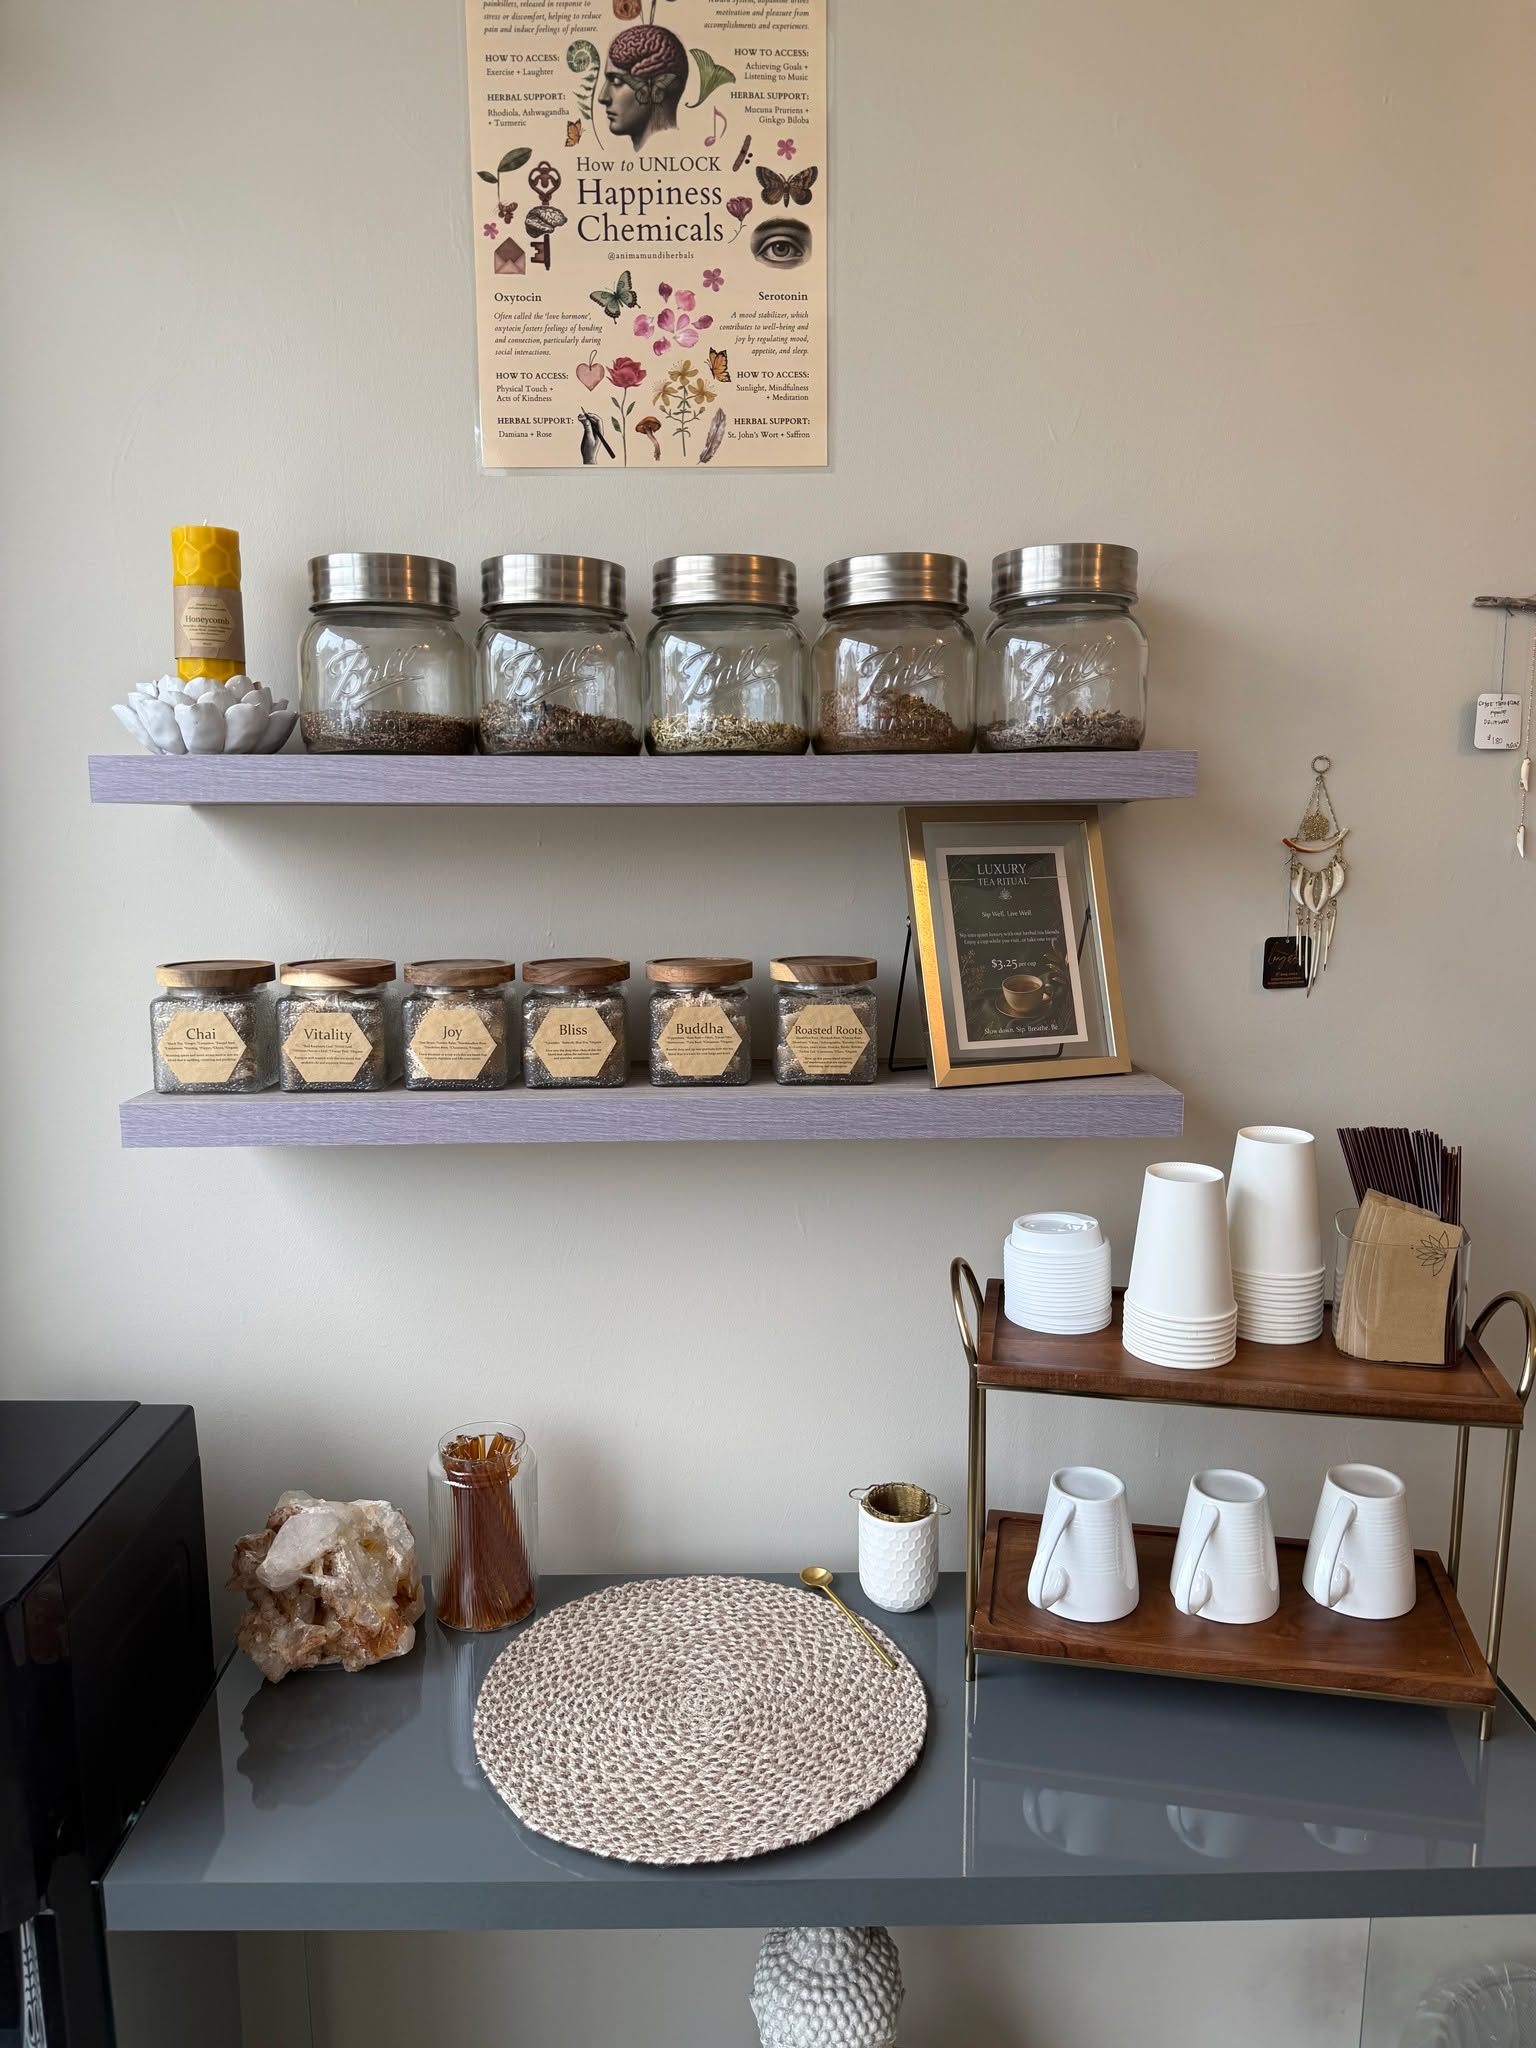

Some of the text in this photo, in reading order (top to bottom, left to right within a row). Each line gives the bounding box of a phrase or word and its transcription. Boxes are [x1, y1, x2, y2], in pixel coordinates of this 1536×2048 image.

[511, 12, 547, 22] discomfort,
[548, 12, 571, 22] helping
[582, 11, 602, 19] reduce
[716, 8, 809, 19] motivation and pleasure from
[484, 24, 598, 35] pain and induce feelings of pleasure.
[704, 20, 809, 32] accomplishments and experiences.
[734, 48, 757, 56] HOW
[775, 49, 809, 57] ACCESS:
[485, 54, 560, 62] HOW TO ACCESS:
[486, 68, 514, 76] Exercise
[523, 67, 554, 77] Laughter
[745, 62, 781, 72] Achieving
[783, 63, 802, 71] Goals
[744, 72, 777, 82] Listening
[779, 73, 786, 81] to
[487, 92, 566, 102] HERBAL SUPPORT:
[730, 91, 809, 100] HERBAL SUPPORT:
[488, 107, 570, 118] Rhodiola, Ashwagandha
[774, 106, 803, 114] Pruriens
[494, 119, 527, 127] Turmeric
[759, 116, 809, 126] Ginkgo Biloba
[576, 156, 721, 172] How to UNLOCK
[577, 178, 722, 215] Happiness
[577, 212, 723, 242] Chemicals
[607, 251, 694, 260] @animamundiherbals
[494, 292, 542, 304] Oxytocin
[758, 291, 808, 301] Serotonin
[494, 312, 512, 321] Often
[514, 312, 532, 320] called
[534, 312, 543, 320] the
[758, 311, 789, 319] stabilizer,
[494, 324, 603, 333] oxytocin fosters feelings of bonding
[763, 323, 795, 332] well-being
[495, 336, 601, 346] and connection, particularly during
[734, 335, 809, 344] joy by regulating mood,
[495, 348, 512, 356] social
[751, 347, 777, 356] appetite,
[792, 347, 808, 356] sleep.
[496, 372, 569, 380] HOW TO ACCESS:
[737, 371, 809, 379] HOW TO ACCESS:
[496, 385, 523, 394] Physical
[525, 385, 548, 393] Touch
[736, 383, 809, 393] Sunlight, Mindfulness
[513, 394, 521, 402] of
[772, 393, 809, 401] Meditation
[497, 417, 574, 425] HERBAL SUPPORT:
[734, 417, 811, 425] HERBAL SUPPORT:
[498, 430, 528, 438] Damiana
[536, 430, 552, 438] Rose
[738, 431, 759, 440] John's
[786, 430, 810, 438] Saffron
[185, 615, 230, 625] Honeycomb
[977, 863, 1027, 875] LUXURY
[978, 877, 1030, 886] TEA RITUAL
[991, 958, 1018, 970] $3.25
[443, 1025, 463, 1040] Joy
[560, 1023, 588, 1036] Bliss
[676, 1022, 724, 1034] Buddha
[795, 1025, 863, 1035] Roasted Roots
[186, 1027, 216, 1040] Chai
[304, 1028, 352, 1043] Vitality
